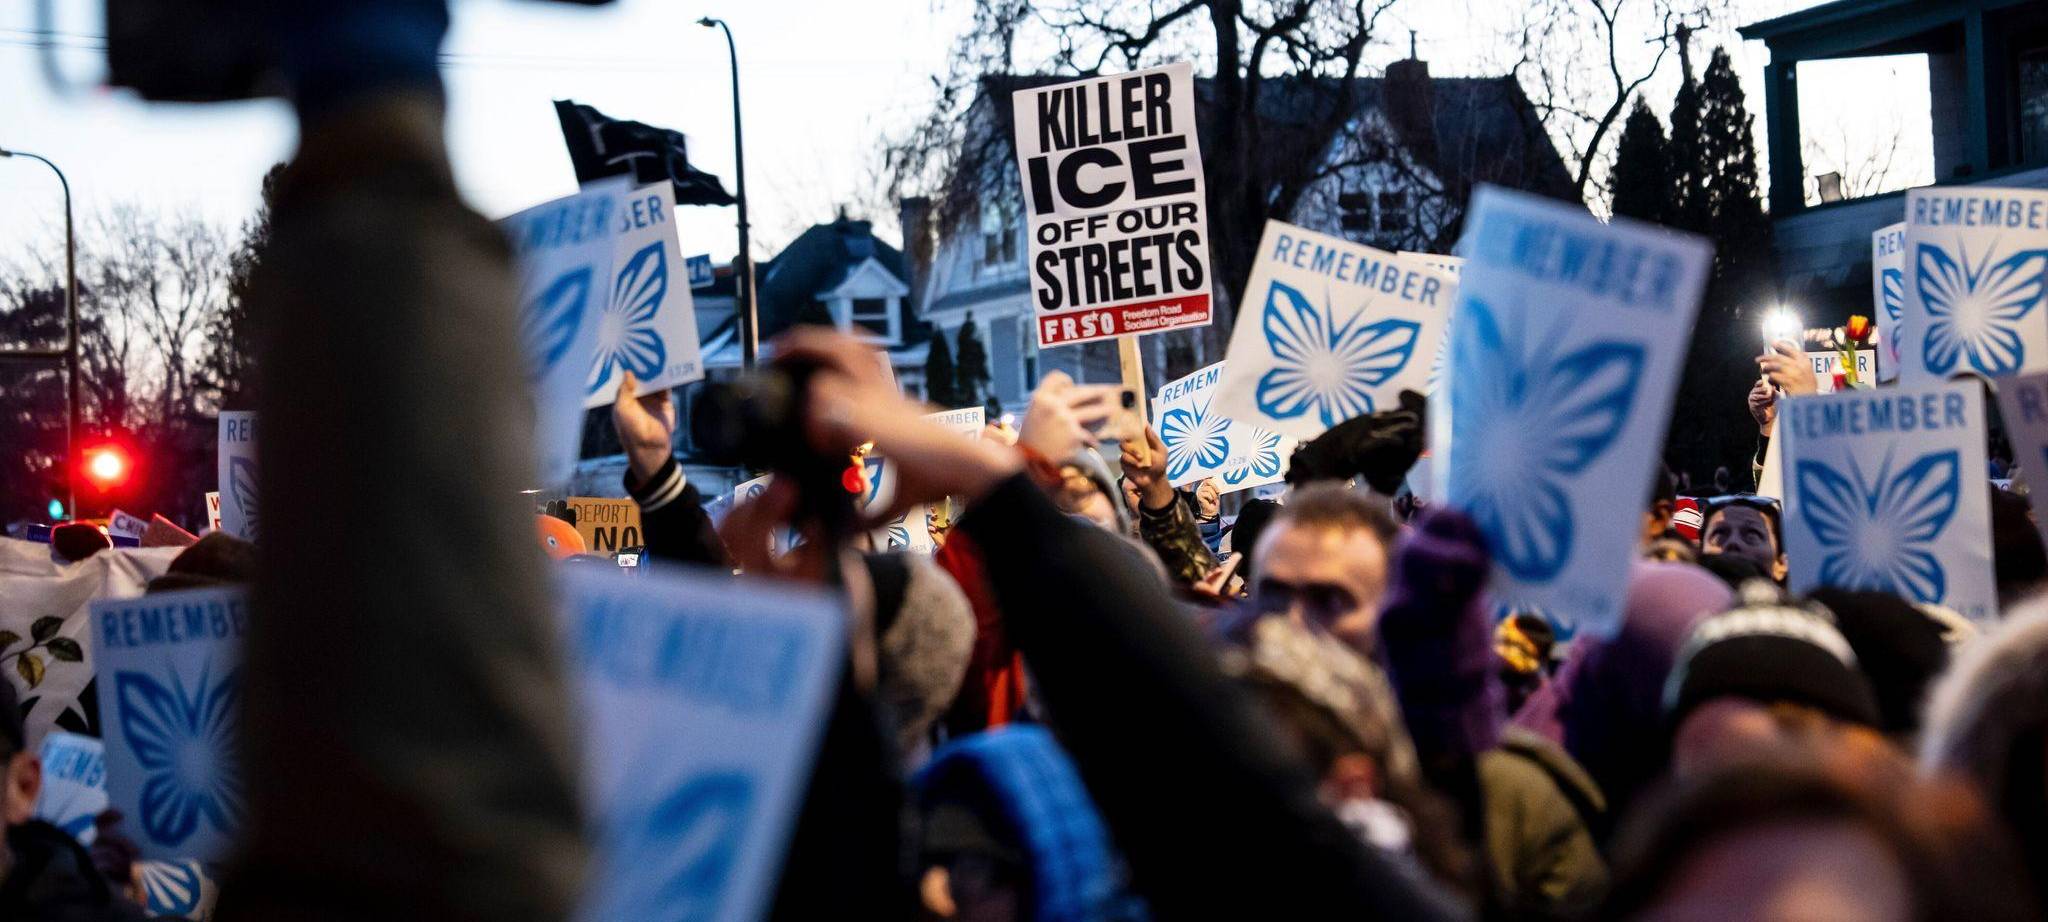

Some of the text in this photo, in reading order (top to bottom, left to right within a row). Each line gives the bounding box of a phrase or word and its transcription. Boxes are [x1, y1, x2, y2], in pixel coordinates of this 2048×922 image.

[1037, 72, 1173, 154] KILLER
[1028, 134, 1196, 216] ICE
[1037, 202, 1199, 246] OFF OUR
[1915, 197, 2048, 229] REMEMBE
[1035, 229, 1204, 311] STREETS
[1272, 234, 1441, 306] REMEMBER
[1044, 311, 1115, 342] FRSO
[1122, 303, 1182, 321] Freedom Road
[1124, 311, 1208, 331] Socialist Organization
[1163, 366, 1225, 405] REMEM
[573, 503, 632, 524] DEPORT
